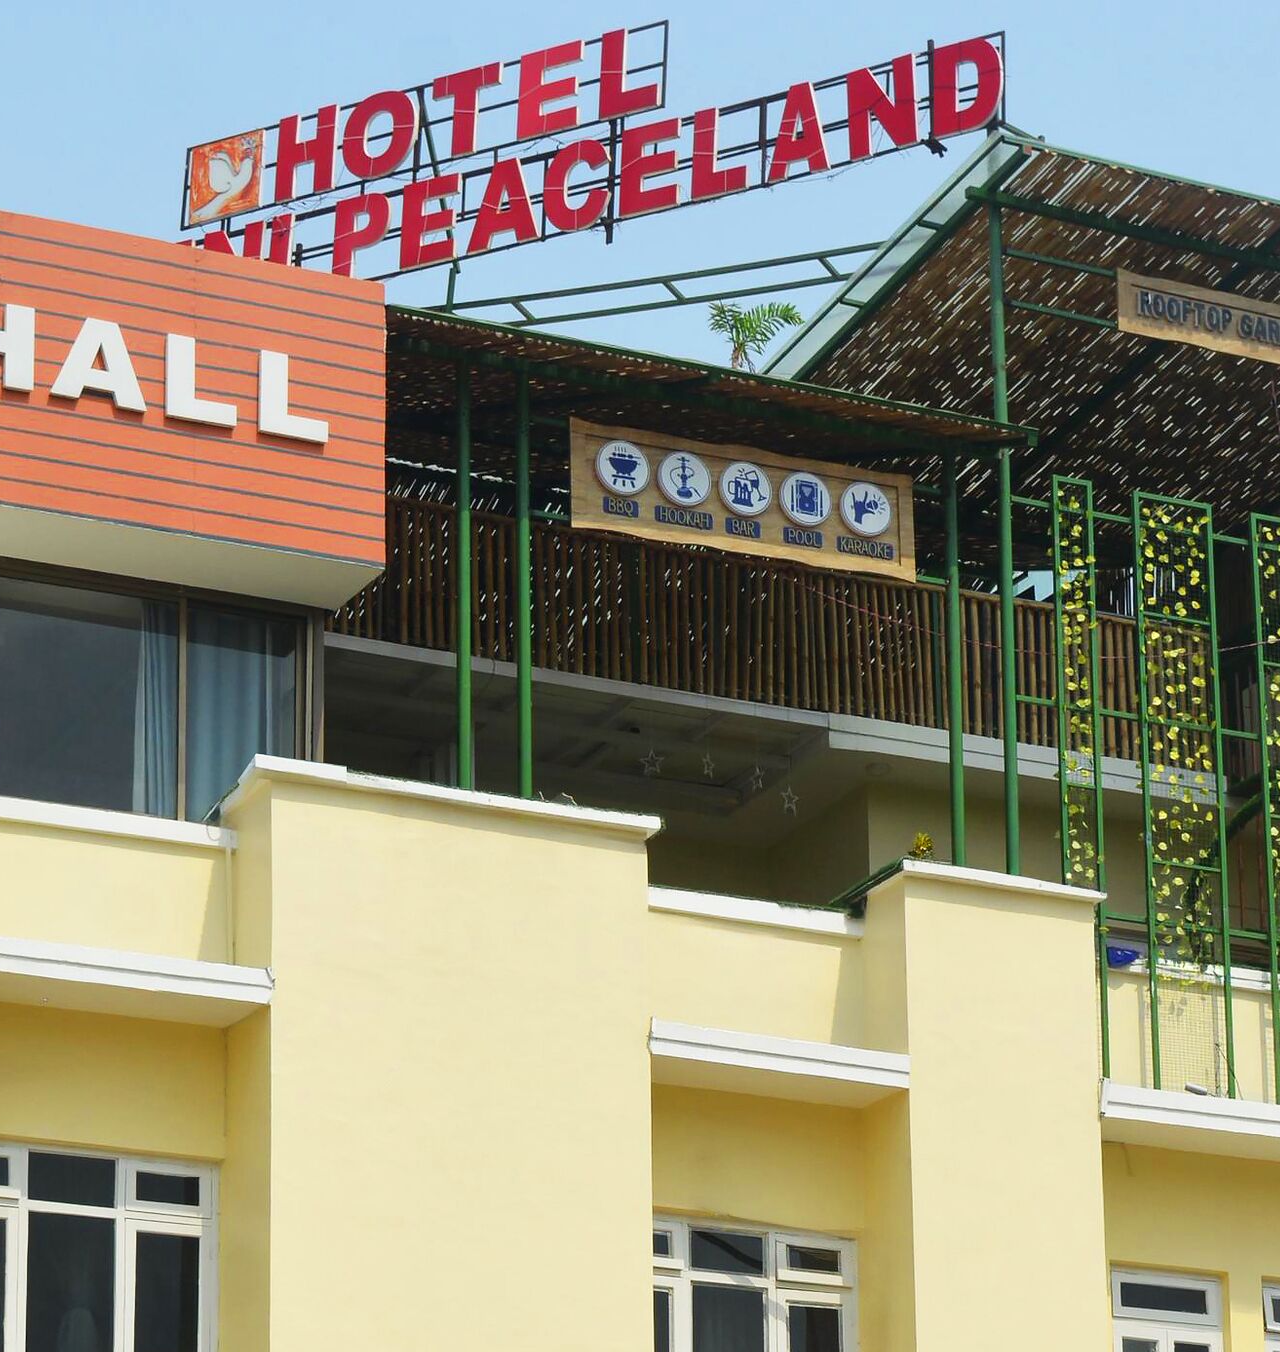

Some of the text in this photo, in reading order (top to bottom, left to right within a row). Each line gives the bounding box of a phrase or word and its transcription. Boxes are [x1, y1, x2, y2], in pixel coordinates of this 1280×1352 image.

[274, 29, 661, 203] HOTEL
[331, 37, 1004, 278] PEACELAND
[1137, 290, 1232, 333] ROOFTOP
[608, 497, 634, 517] BBQ
[658, 505, 710, 530] HOOKAH
[731, 518, 756, 537] BAR
[787, 527, 822, 548] POOL
[839, 537, 893, 560] KARAOKE
